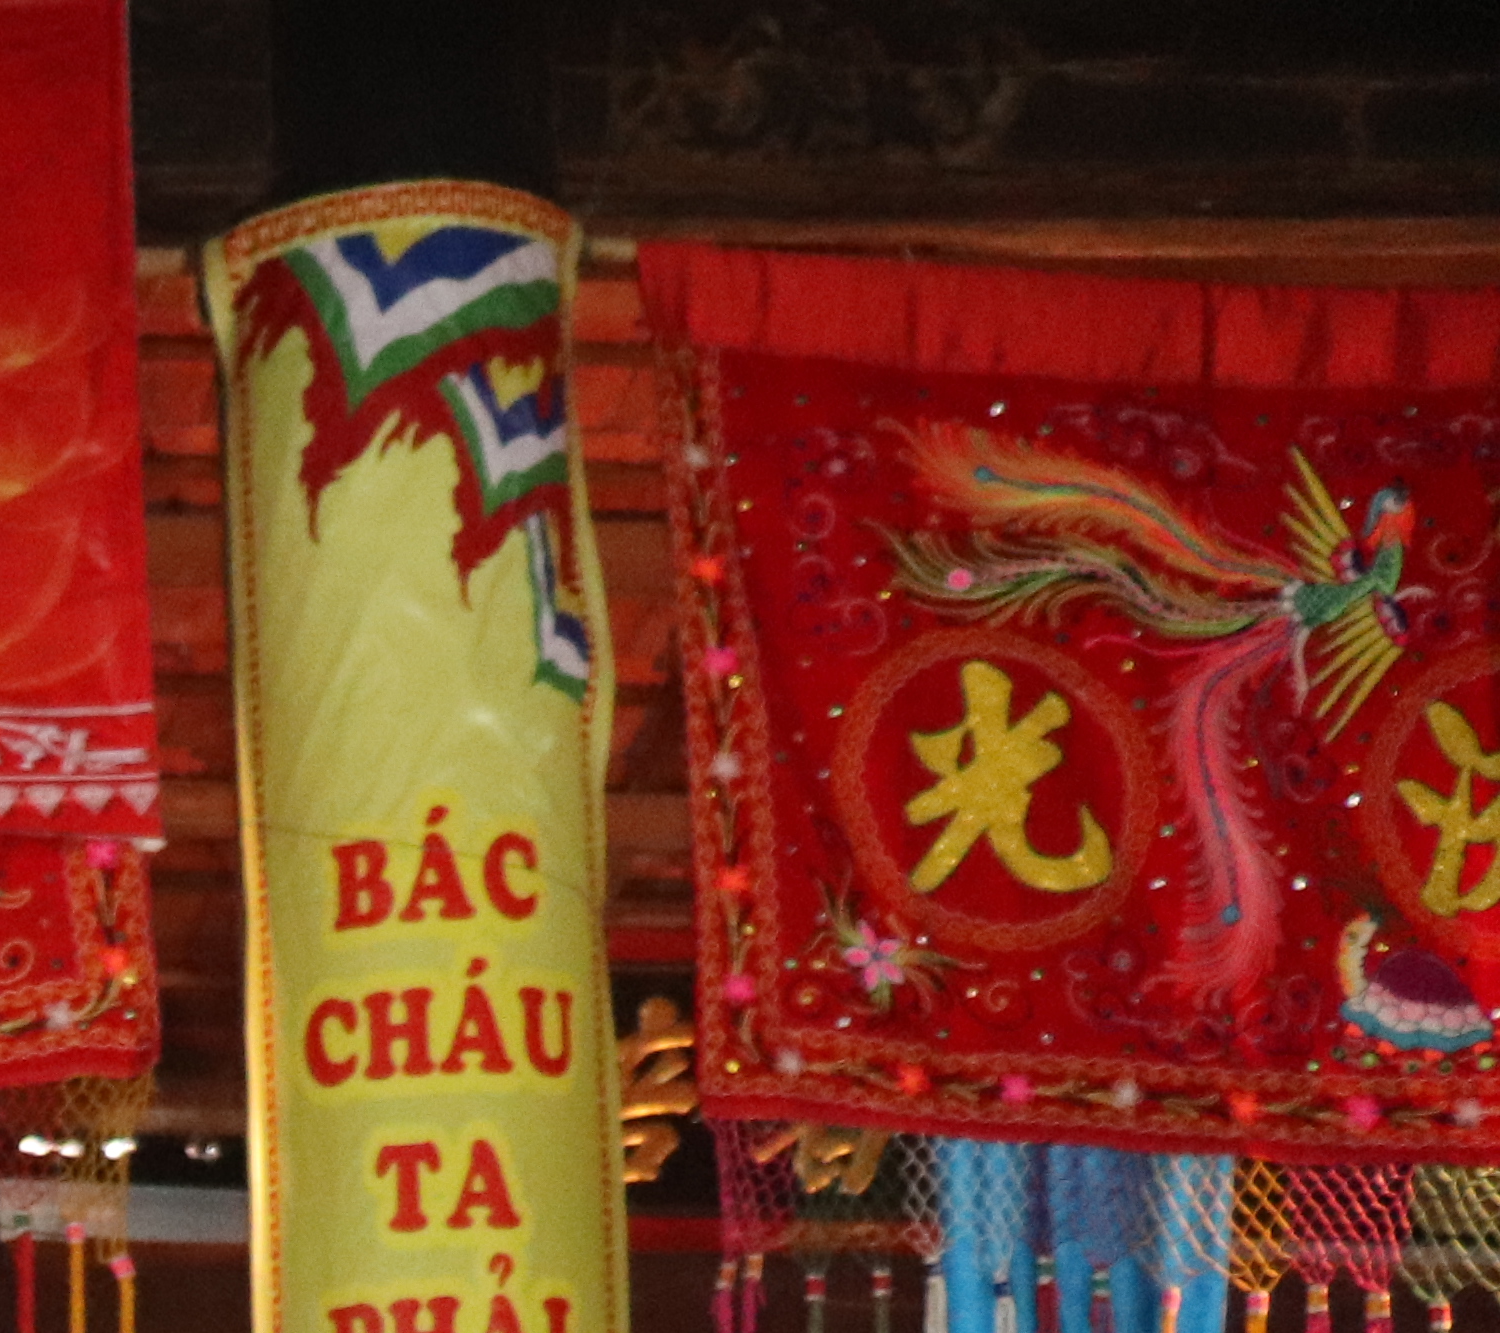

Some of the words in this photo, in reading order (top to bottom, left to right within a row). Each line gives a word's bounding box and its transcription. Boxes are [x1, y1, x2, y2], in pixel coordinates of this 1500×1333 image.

[905, 658, 1112, 894] 光
[329, 803, 540, 934] BÁC
[302, 955, 576, 1090] CHÁU
[374, 1137, 523, 1233] TA
